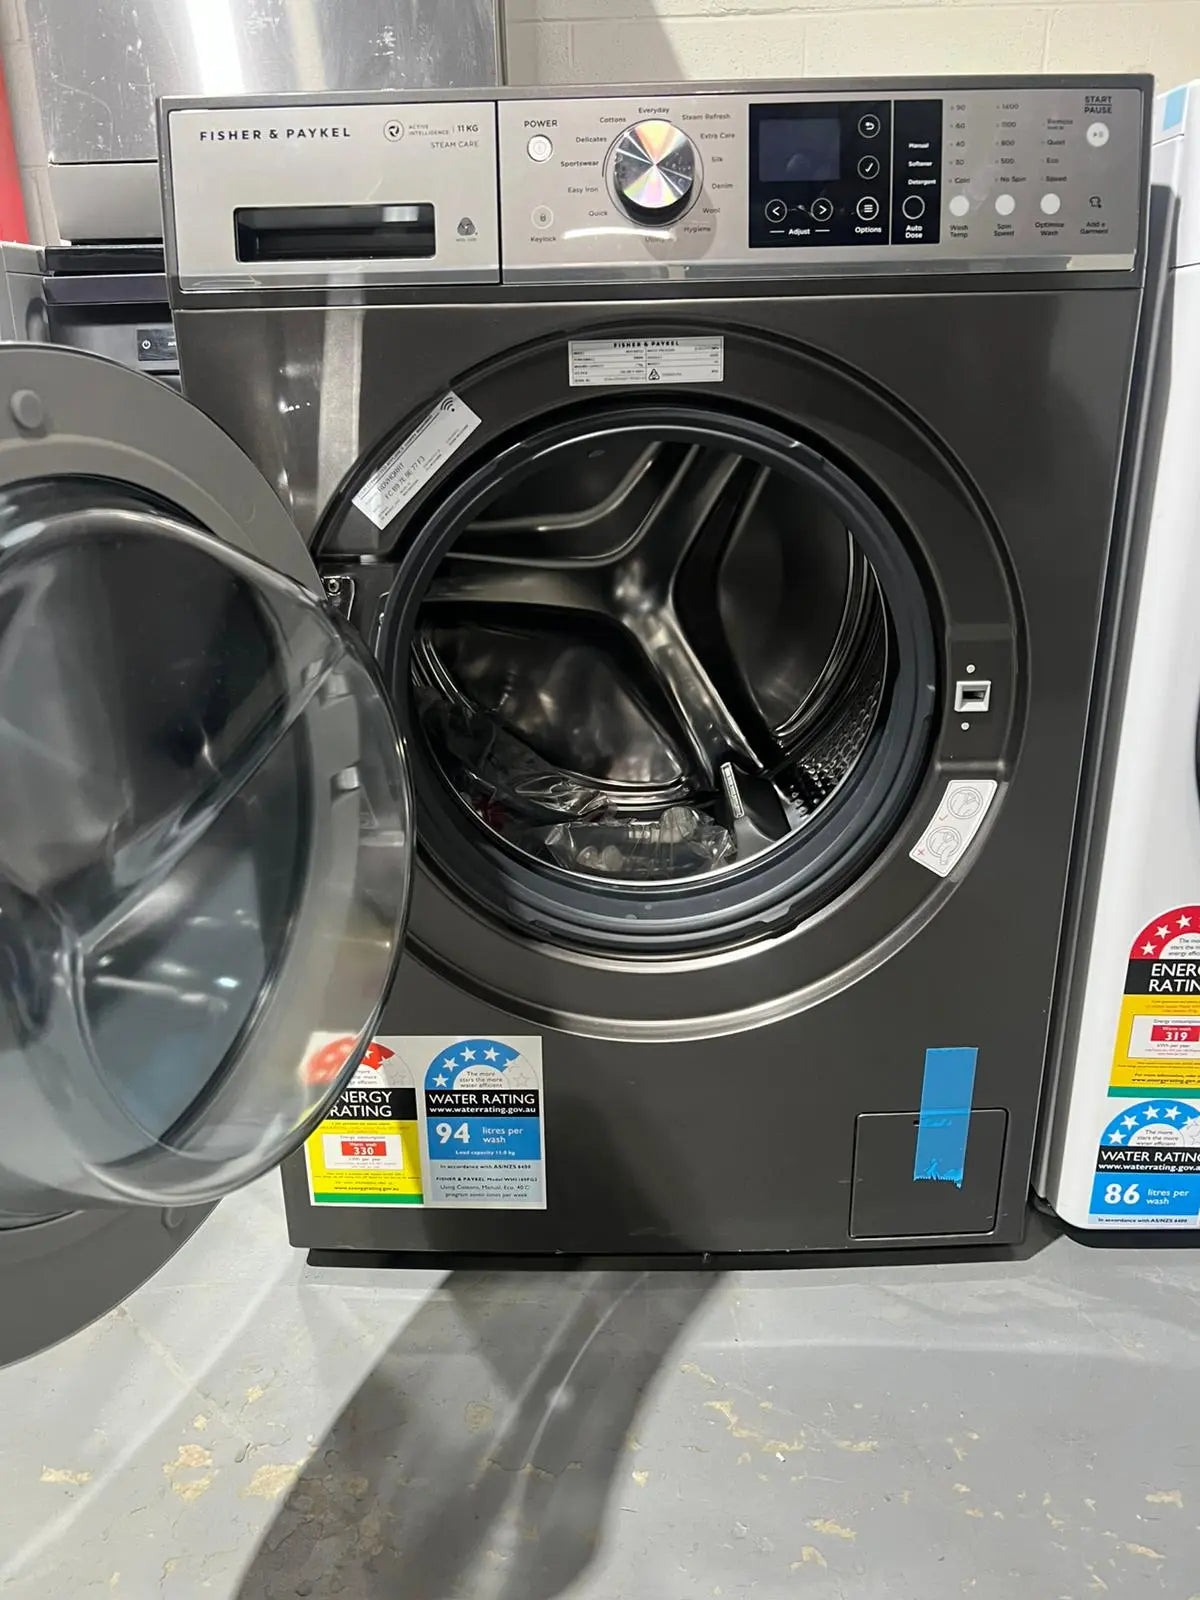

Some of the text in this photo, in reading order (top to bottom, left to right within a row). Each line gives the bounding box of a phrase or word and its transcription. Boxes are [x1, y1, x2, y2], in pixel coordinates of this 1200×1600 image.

[1084, 106, 1112, 114] PAUSE
[466, 124, 479, 132] KG
[524, 120, 558, 128] POWER
[200, 127, 351, 142] FISHER & PAYKEL
[431, 140, 479, 149] STEAM CARE
[575, 136, 607, 144] Delicates
[560, 159, 600, 168] Sportswear
[567, 186, 583, 194] Easy
[711, 182, 733, 190] Denim
[683, 226, 711, 234] Hygiene
[788, 228, 811, 236] Adjust
[855, 226, 882, 234] Options
[530, 235, 557, 243] Keylock
[1151, 963, 1200, 977] ENER
[1165, 1032, 1188, 1041] 319
[340, 1091, 392, 1103] NERGY
[429, 1093, 535, 1104] WATER RATING
[330, 1105, 392, 1117] RATING
[429, 1106, 536, 1115] www.waterrating.gov.au
[435, 1122, 471, 1144] 94
[482, 1126, 523, 1136] litres per
[353, 1147, 374, 1155] 330
[1101, 1151, 1150, 1162] WATER
[1104, 1183, 1140, 1204] 86
[1147, 1188, 1189, 1198] litres per
[1145, 1197, 1169, 1205] wash
